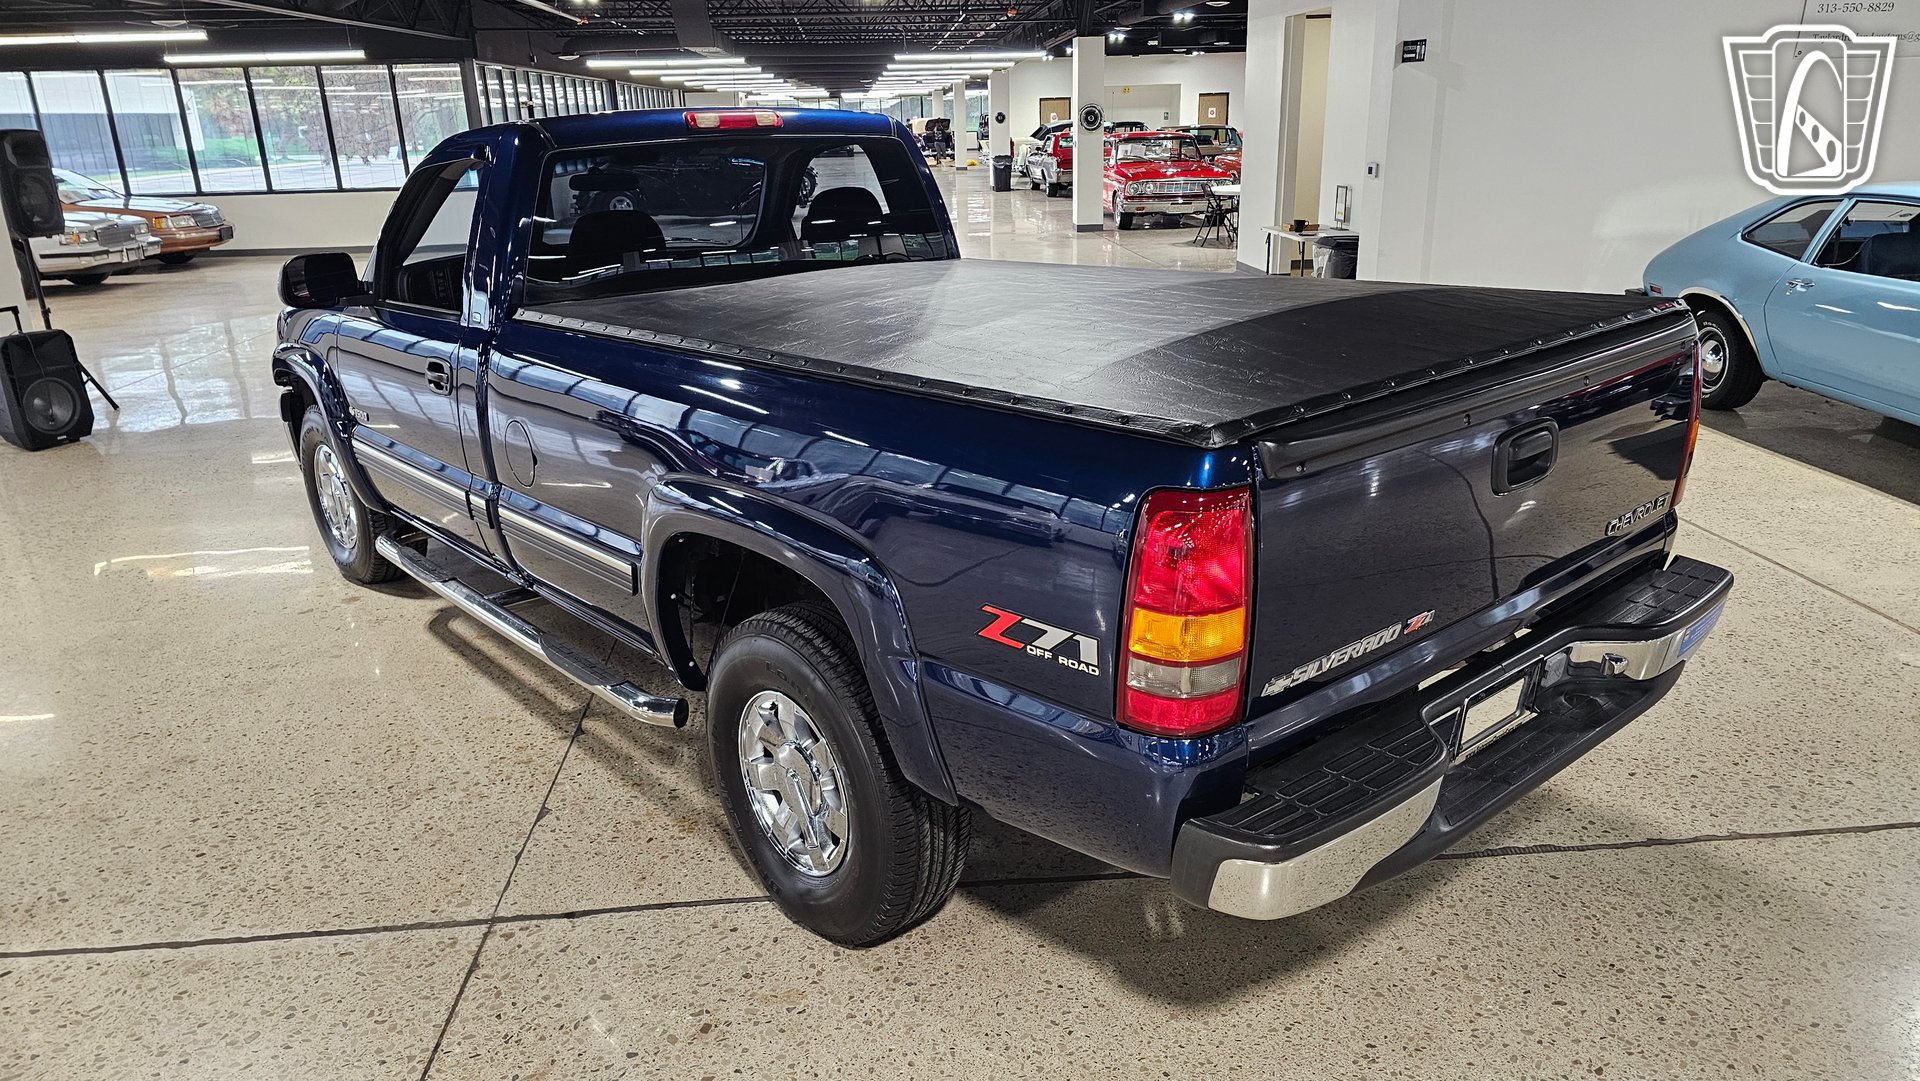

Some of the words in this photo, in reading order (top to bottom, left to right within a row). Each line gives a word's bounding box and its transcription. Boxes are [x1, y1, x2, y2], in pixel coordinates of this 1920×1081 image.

[1817, 2, 1895, 13] 313-550-8829
[1606, 494, 1671, 536] CHEVROLET
[978, 604, 1099, 667] Z71
[1291, 622, 1402, 687] SILVERADO
[1403, 609, 1435, 634] Z71
[1026, 645, 1053, 660] OFF
[1058, 655, 1100, 677] ROAD
